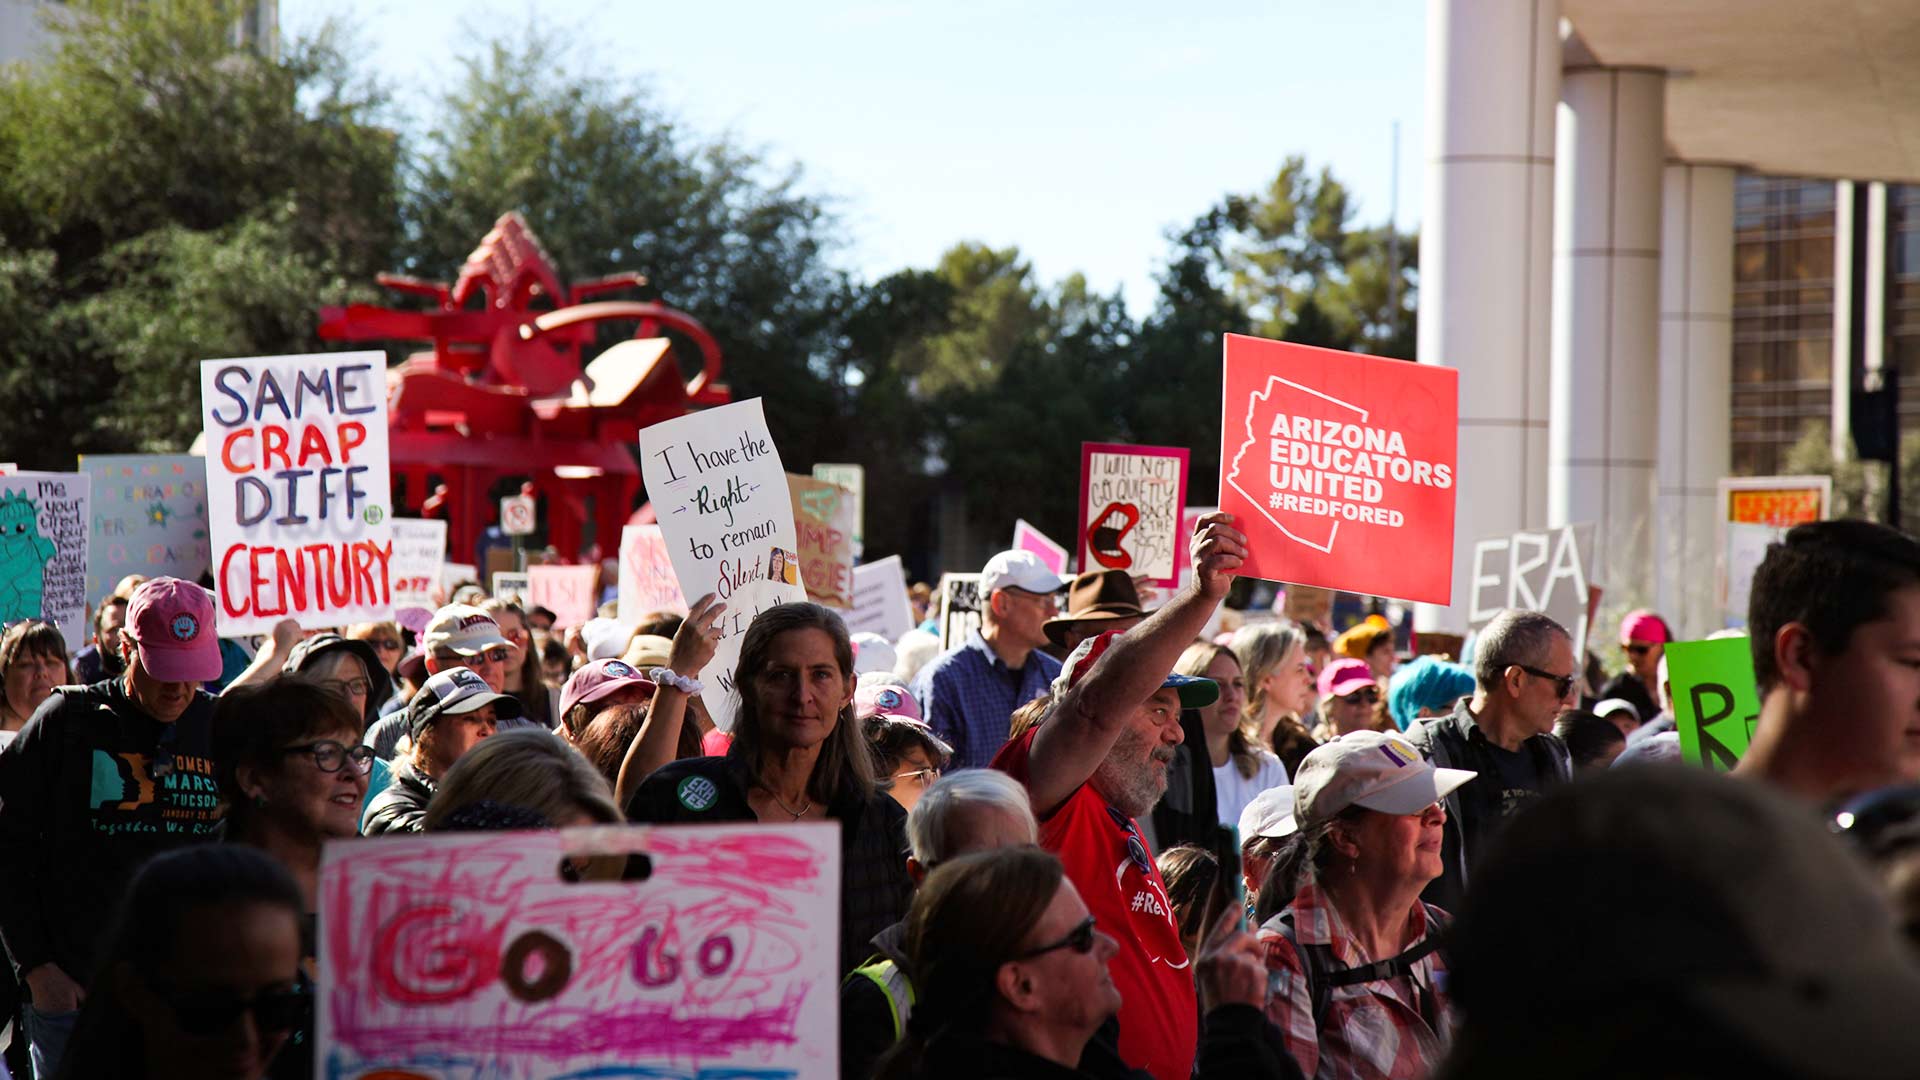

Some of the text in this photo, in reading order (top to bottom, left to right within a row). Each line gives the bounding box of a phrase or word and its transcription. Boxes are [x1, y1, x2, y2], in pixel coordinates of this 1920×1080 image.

[212, 365, 376, 427] SAME
[221, 421, 366, 474] CRAP
[654, 430, 770, 484] I have the
[1270, 413, 1407, 456] ARIZONA
[1103, 454, 1133, 477] WILL
[1140, 456, 1176, 483] NOT
[1270, 464, 1383, 504] UNITED
[1271, 438, 1453, 489] EDUCATORS
[235, 466, 369, 527] DIFF
[690, 476, 750, 527] Right
[1269, 491, 1405, 528] #REDFORED
[690, 519, 777, 560] to remain
[220, 538, 393, 618] CENTURY
[718, 555, 764, 600] Silent,
[1469, 525, 1589, 624] ERA
[164, 774, 218, 792] MARC
[680, 785, 708, 809] YES
[688, 777, 716, 801] ERA
[91, 818, 157, 835] Together
[166, 821, 185, 833] We
[372, 904, 572, 1005] Go
